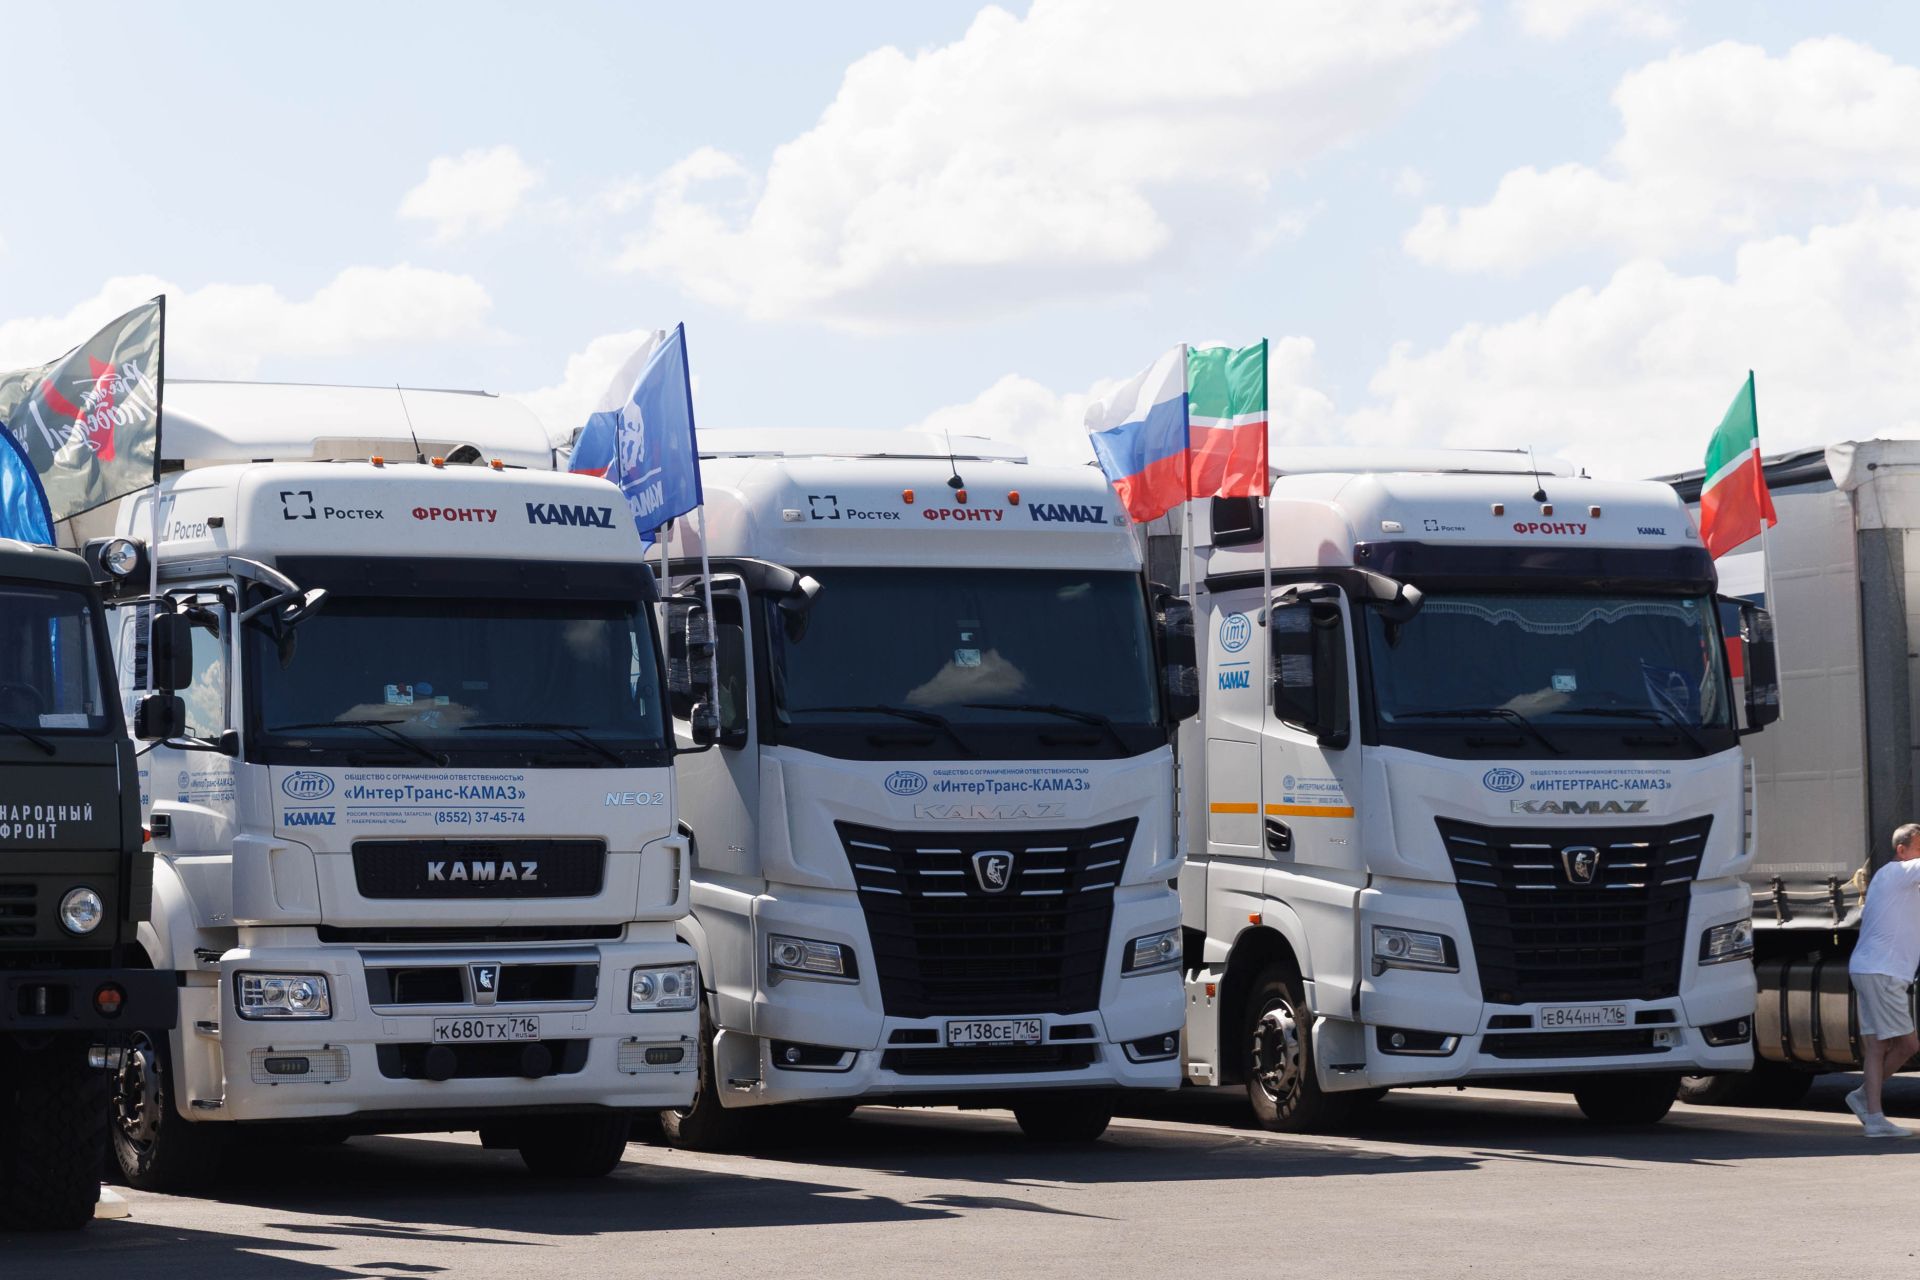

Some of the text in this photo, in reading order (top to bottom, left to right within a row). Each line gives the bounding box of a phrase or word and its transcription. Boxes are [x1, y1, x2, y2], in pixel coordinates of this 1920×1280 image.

[323, 506, 498, 523] Ростех ФРОНТУ
[525, 502, 617, 530] KAMAZ
[846, 508, 1004, 522] Ростех ФРОНТУ
[1028, 503, 1108, 525] KAMAZ
[174, 520, 208, 541] Ростех
[1441, 522, 1588, 536] Ростех ФРОНТУ
[1636, 526, 1667, 537] KAMAZ
[1218, 670, 1250, 690] KAMAZ
[344, 773, 385, 781] ОБЩЕСТВО
[392, 773, 449, 781] ОГРАНИЧЕННОЙ
[449, 774, 525, 782] ОТВЕТСТВЕННОСТЬЮ
[975, 768, 1024, 776] ОГРАНИЧЕННОЙ
[344, 784, 527, 803] «ИнтерТранс-КАМАЗ»
[932, 778, 1091, 796] «ИнтерТранс-КАМАЗ»
[1529, 779, 1673, 792] «ИНТЕРТРАНС-КАМАЗ»
[604, 791, 665, 807] NEO2
[1510, 799, 1650, 815] KAMAZ
[0, 802, 93, 821] НАРОДНЫЙ
[284, 811, 337, 827] KAMAZ
[434, 811, 526, 827] (8552) 37-45-74
[912, 802, 1066, 820] KAMAZ
[0, 823, 58, 840] ФРОНТ
[428, 861, 539, 882] KAMAZ
[1602, 1007, 1622, 1020] 716
[510, 1018, 535, 1033] 716
[1014, 1021, 1037, 1035] 716
